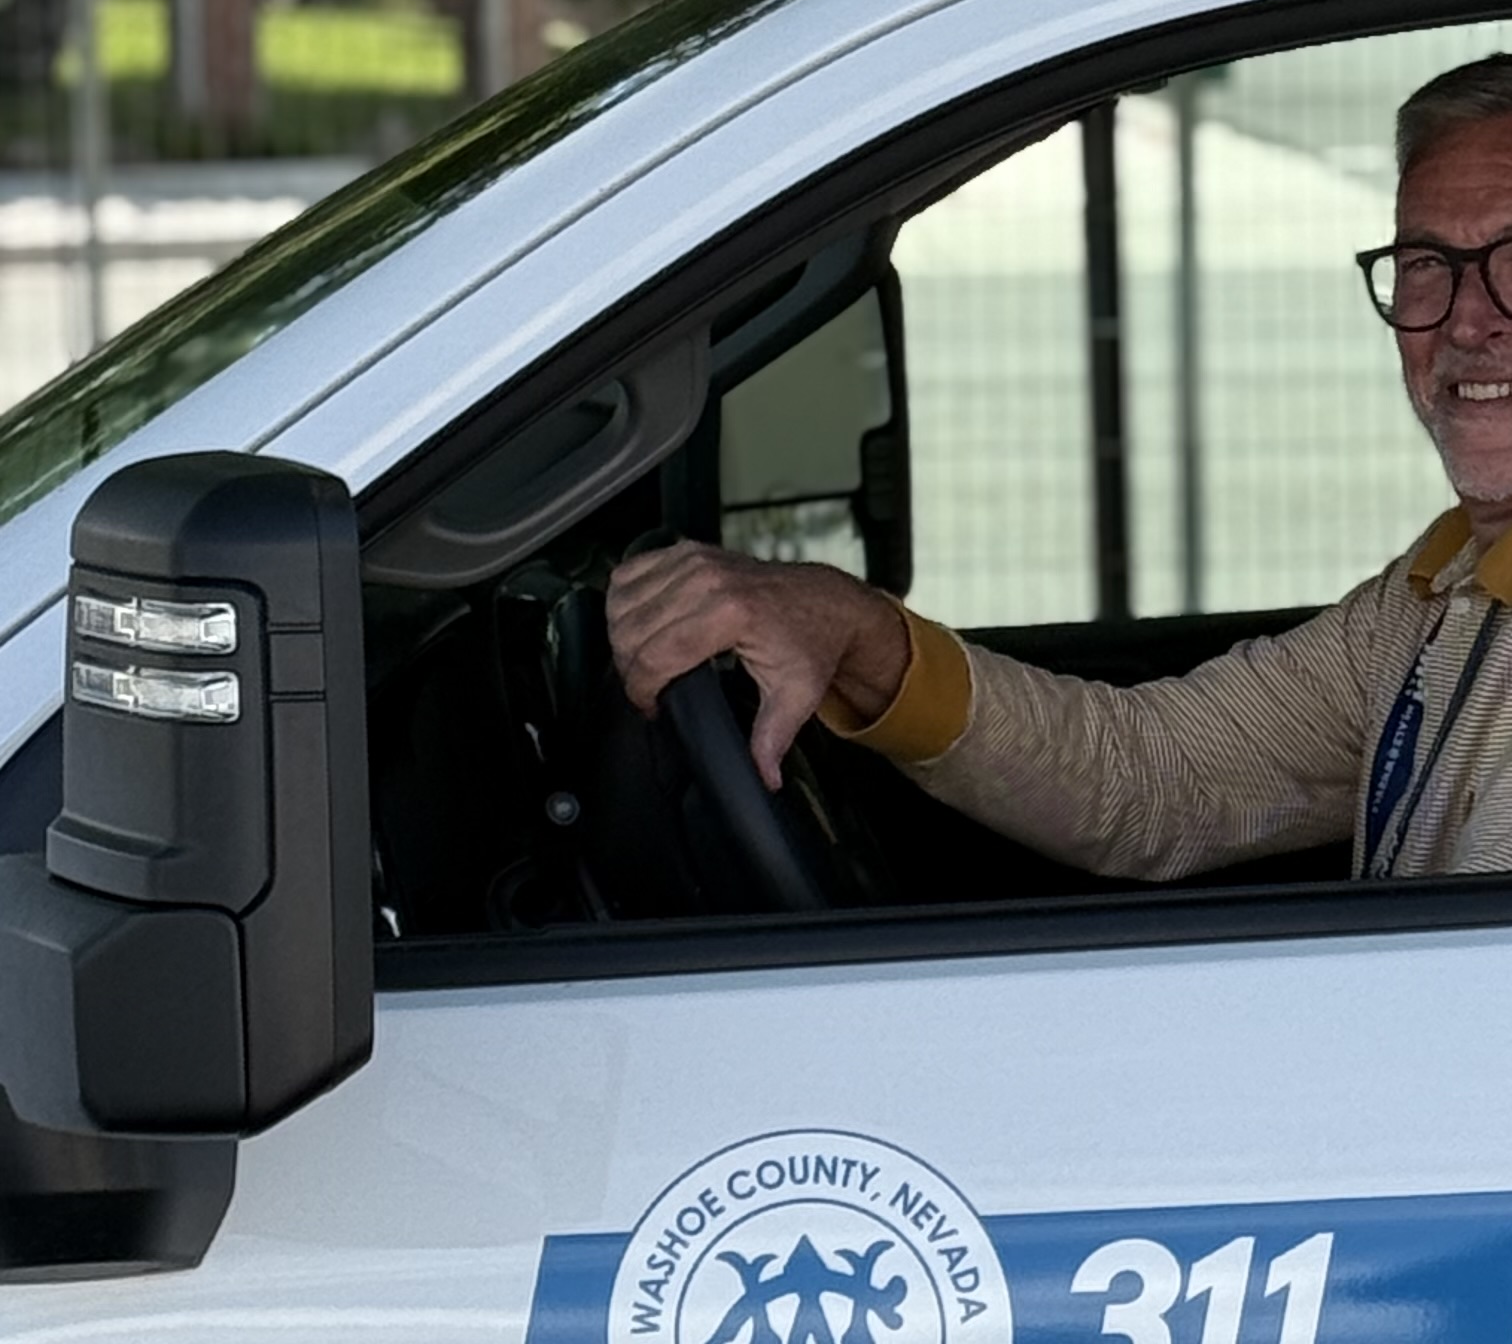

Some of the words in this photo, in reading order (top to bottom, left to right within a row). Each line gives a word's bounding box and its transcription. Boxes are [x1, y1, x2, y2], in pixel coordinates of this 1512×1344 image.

[630, 1187, 726, 1335] WASHOE
[726, 1154, 882, 1202] COUNTY,
[888, 1181, 988, 1324] NEVADA
